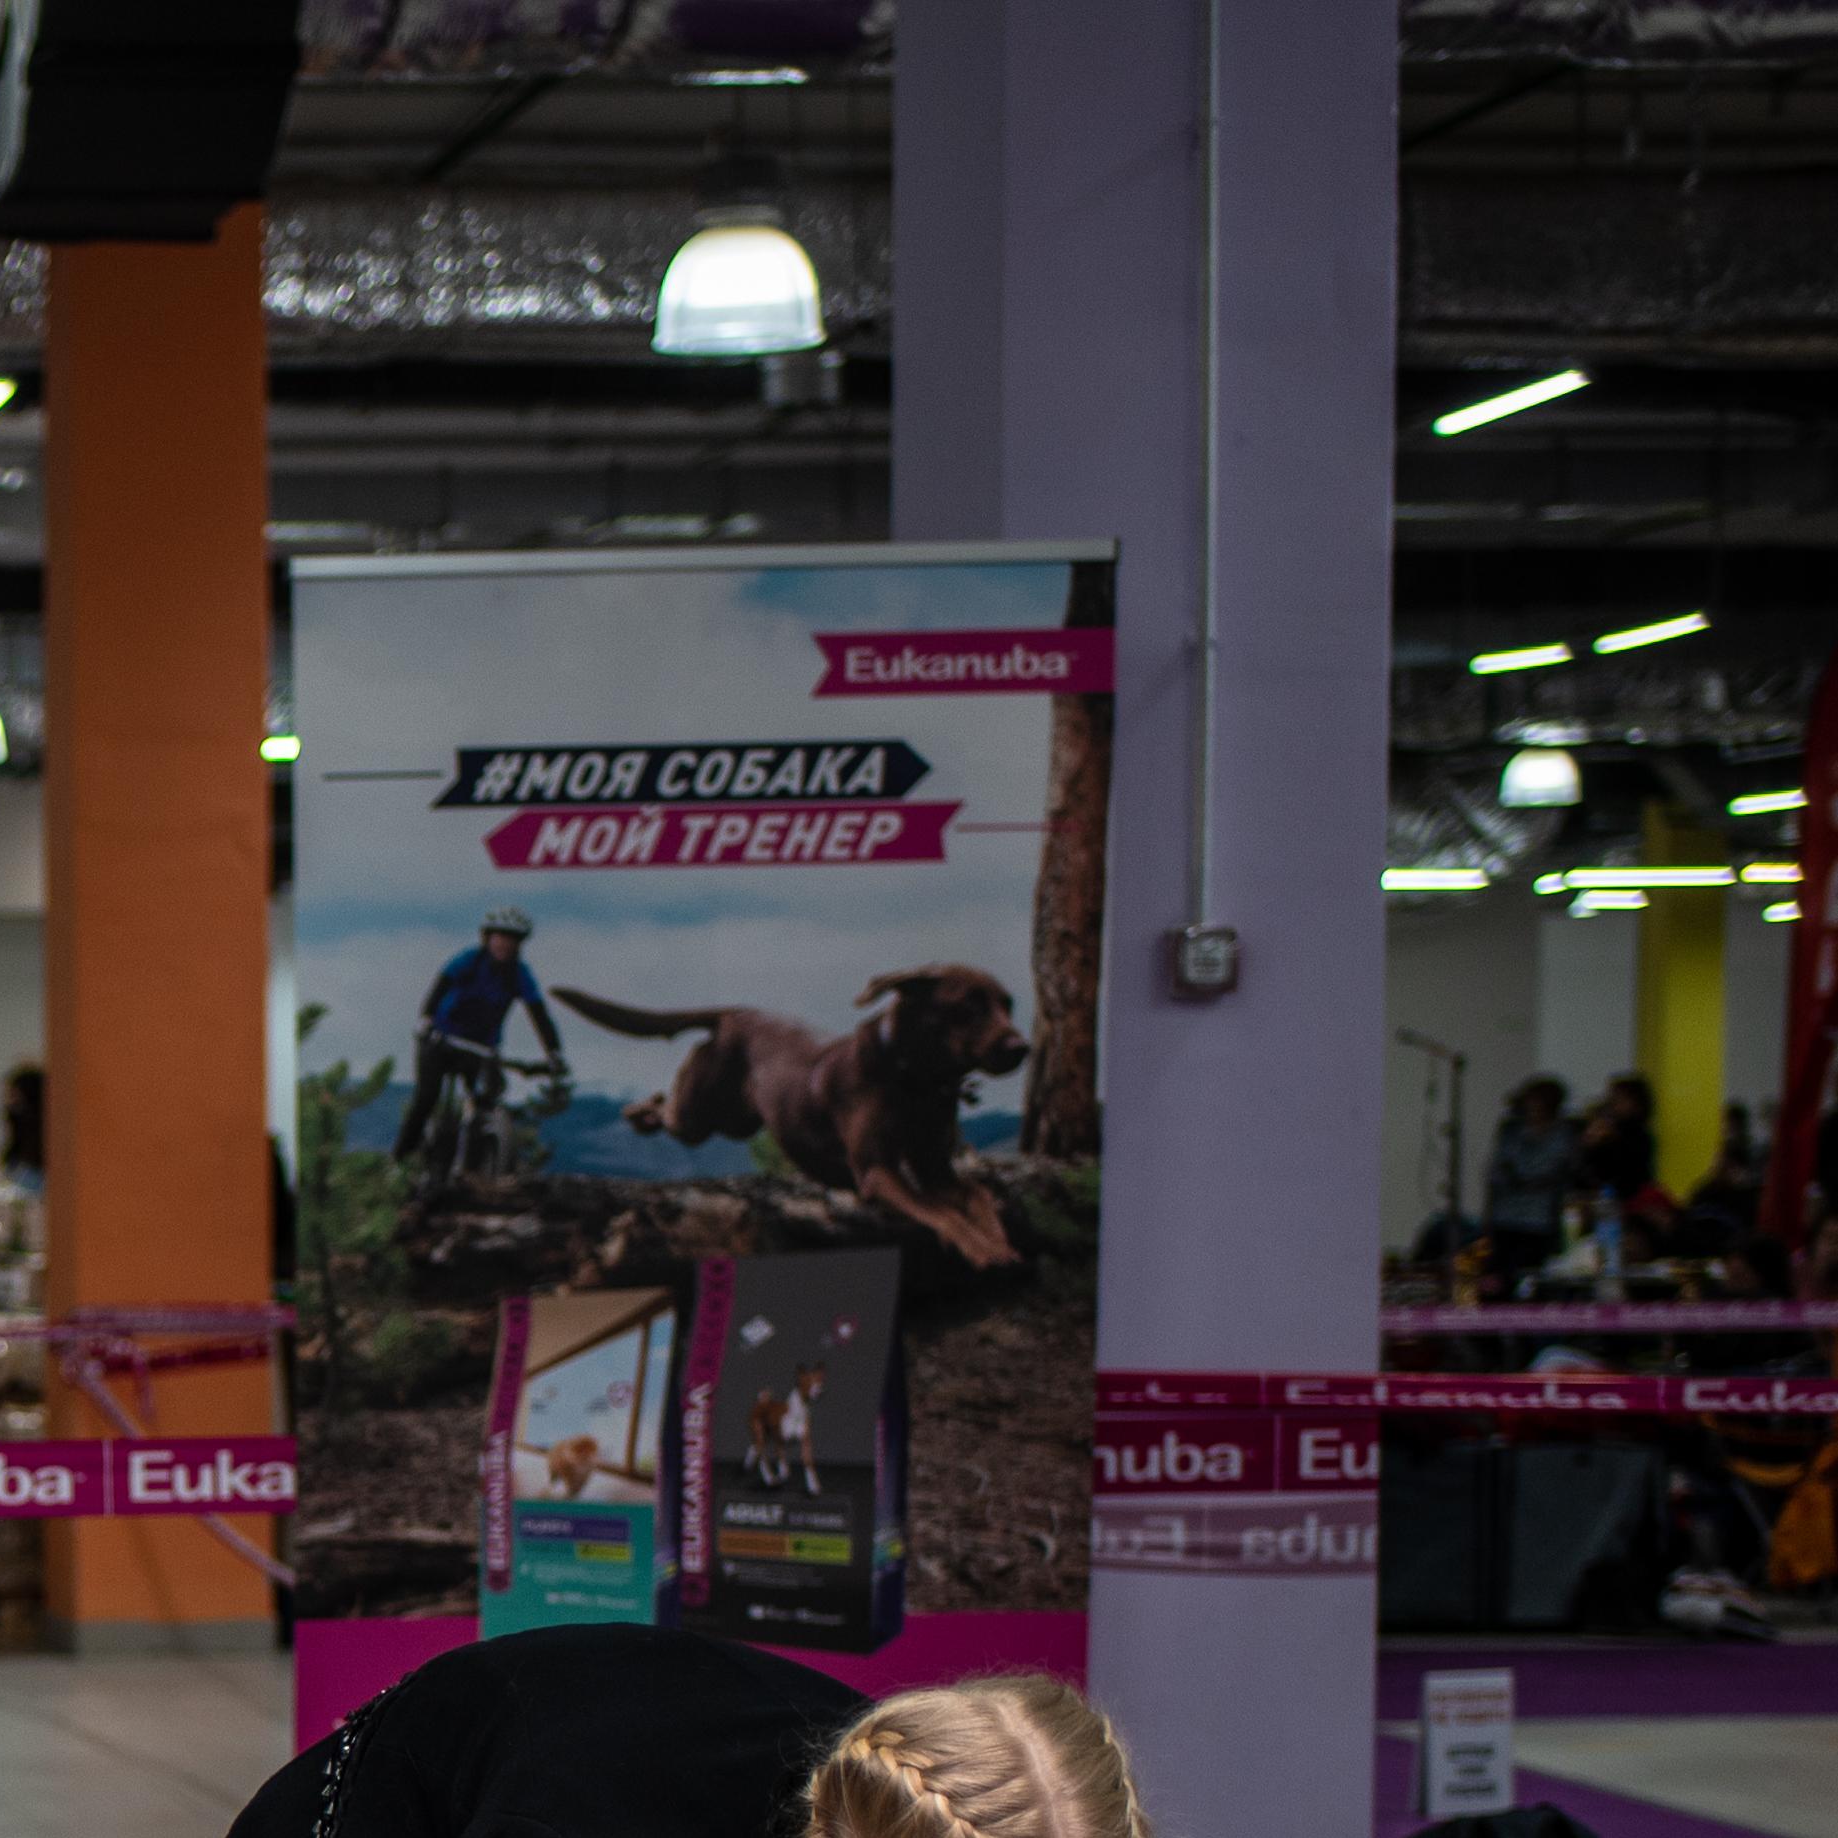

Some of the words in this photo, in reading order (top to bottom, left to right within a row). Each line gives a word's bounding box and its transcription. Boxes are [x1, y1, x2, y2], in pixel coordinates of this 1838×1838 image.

[843, 643, 1070, 685] Eukanuba
[472, 751, 644, 803] #МОЯ
[656, 744, 887, 799] СОБАКА
[526, 806, 659, 866] МОЙ
[678, 810, 904, 863] ТРЕНЕР
[681, 1382, 713, 1573] EUKANUBA
